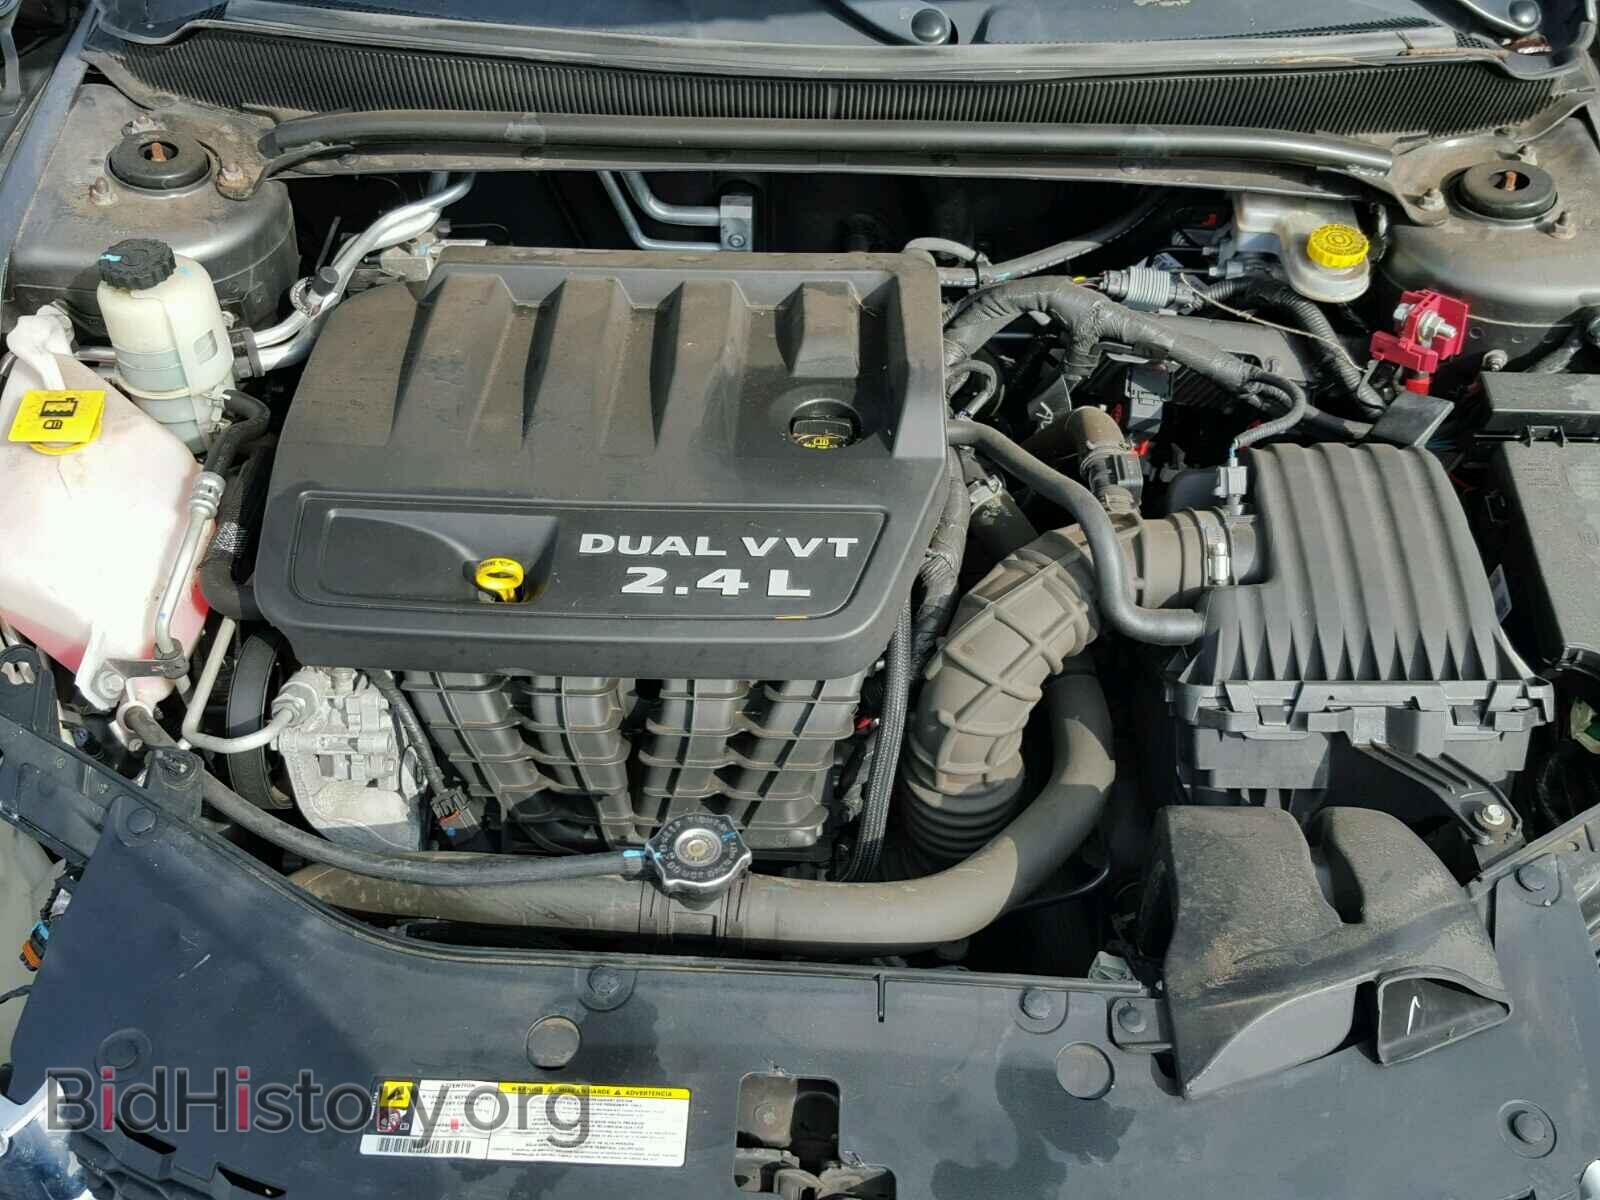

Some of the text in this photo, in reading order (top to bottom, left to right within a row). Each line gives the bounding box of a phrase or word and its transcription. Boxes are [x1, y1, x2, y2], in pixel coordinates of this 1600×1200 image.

[579, 533, 859, 557] DUAL VVT
[625, 1090, 673, 1098] ADVERTENCIA
